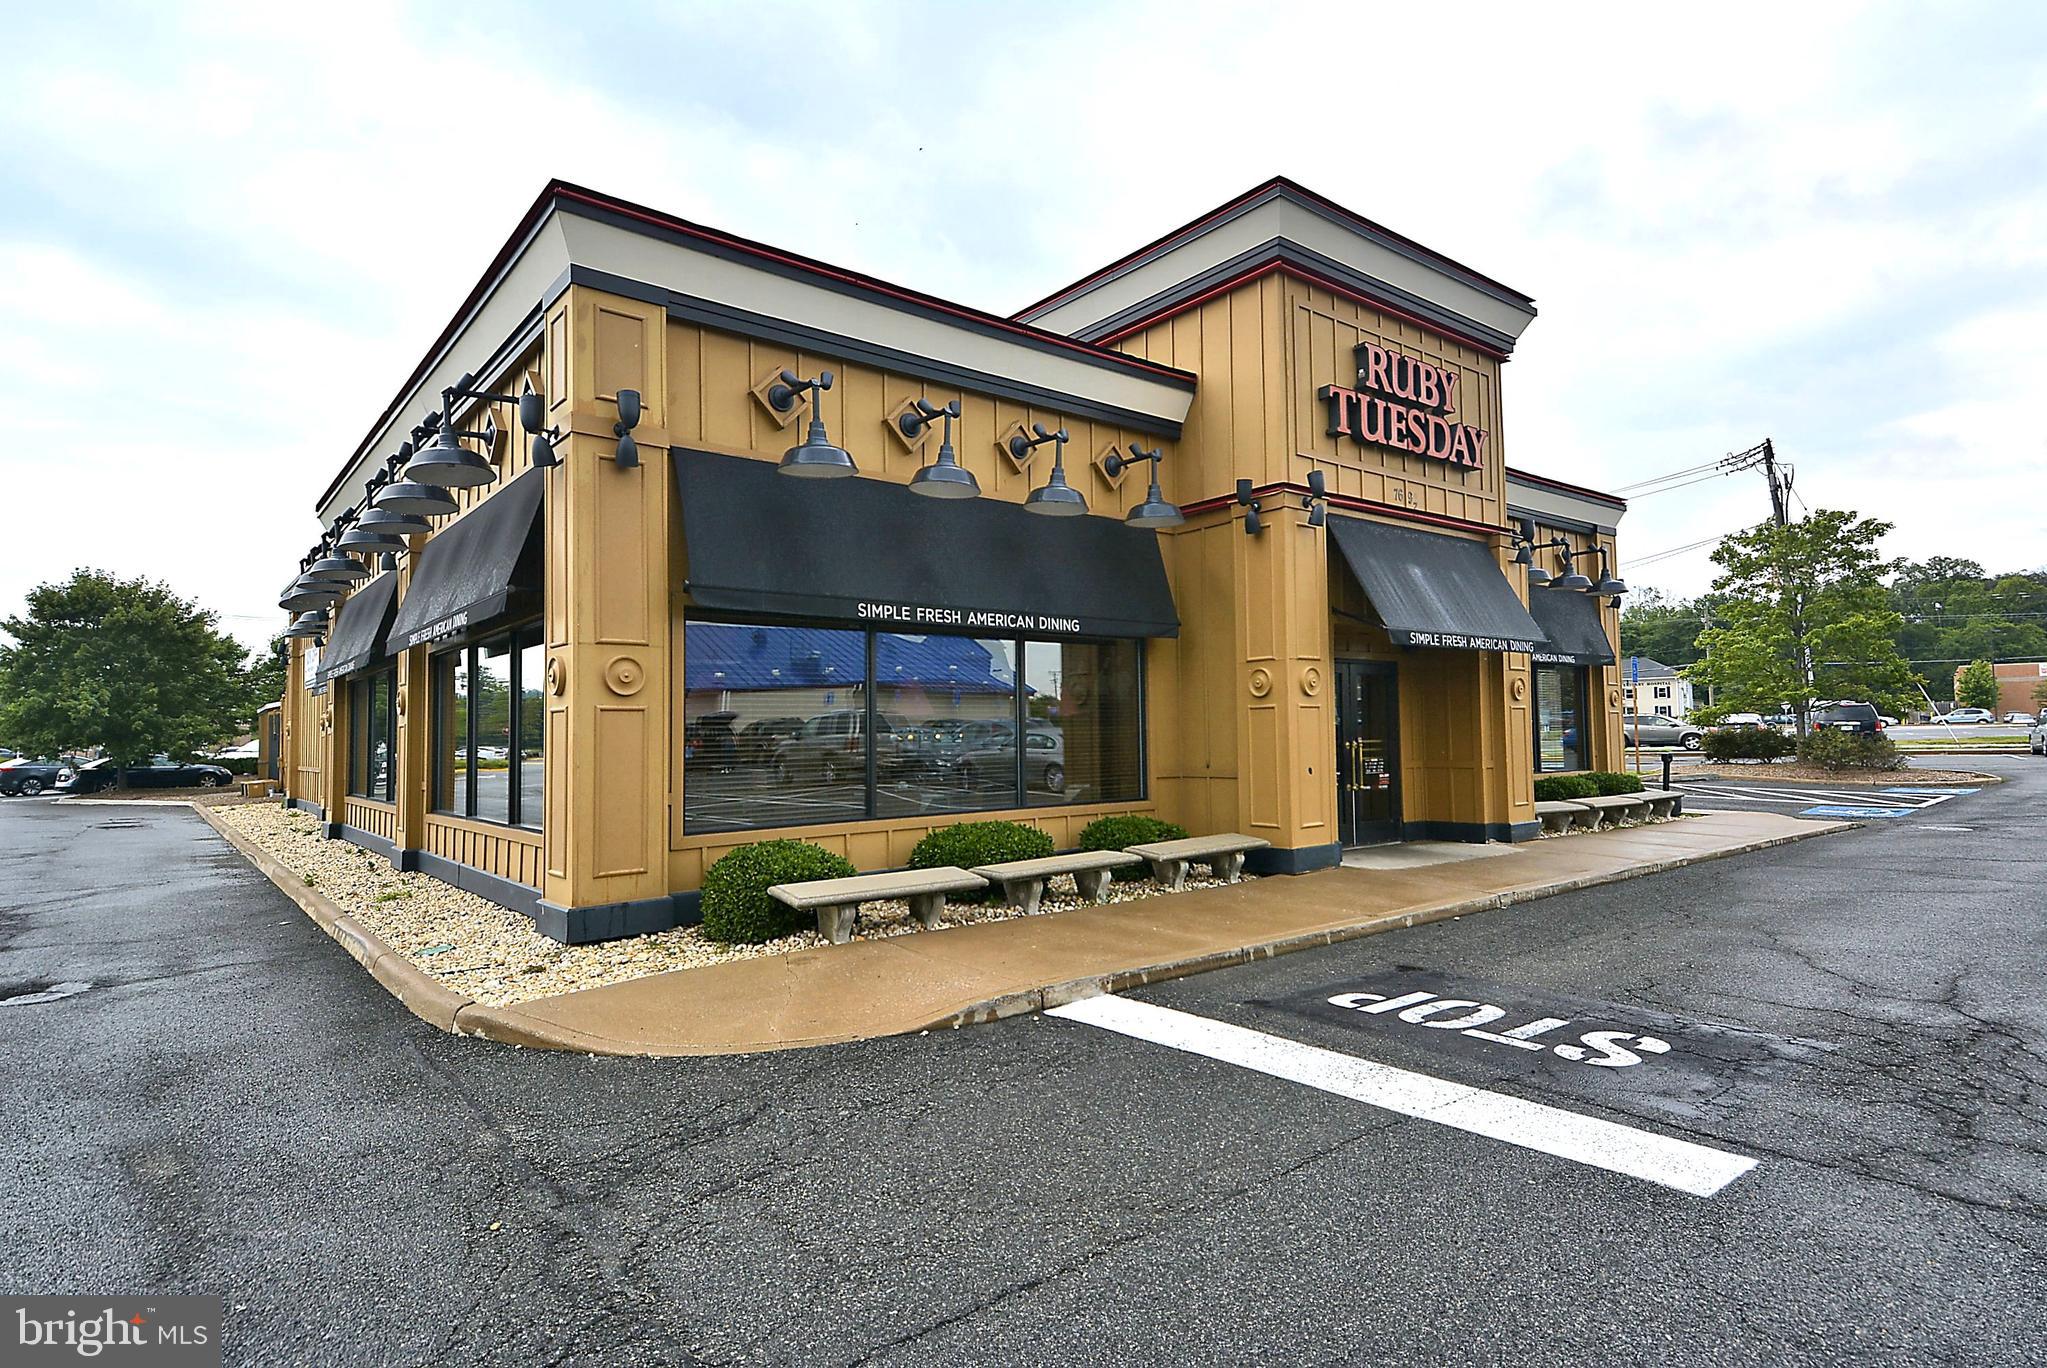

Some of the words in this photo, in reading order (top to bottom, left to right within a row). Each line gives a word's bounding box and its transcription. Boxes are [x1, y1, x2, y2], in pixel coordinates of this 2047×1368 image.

[1364, 342, 1460, 413] RUBY
[1328, 385, 1488, 469] TUESDAY
[857, 602, 911, 621] SIMPLE
[916, 607, 961, 624] FRESH
[967, 611, 1034, 629] AMERICAN
[1039, 616, 1081, 633] DINING
[1409, 631, 1440, 646] SIMPLE
[1441, 634, 1468, 648] FRESH
[1470, 637, 1508, 651] AMERICAN
[1510, 640, 1534, 652] DINING
[1532, 653, 1558, 663] AMERICAN
[1558, 654, 1576, 664] DINING
[1327, 991, 1672, 1067] STOP
